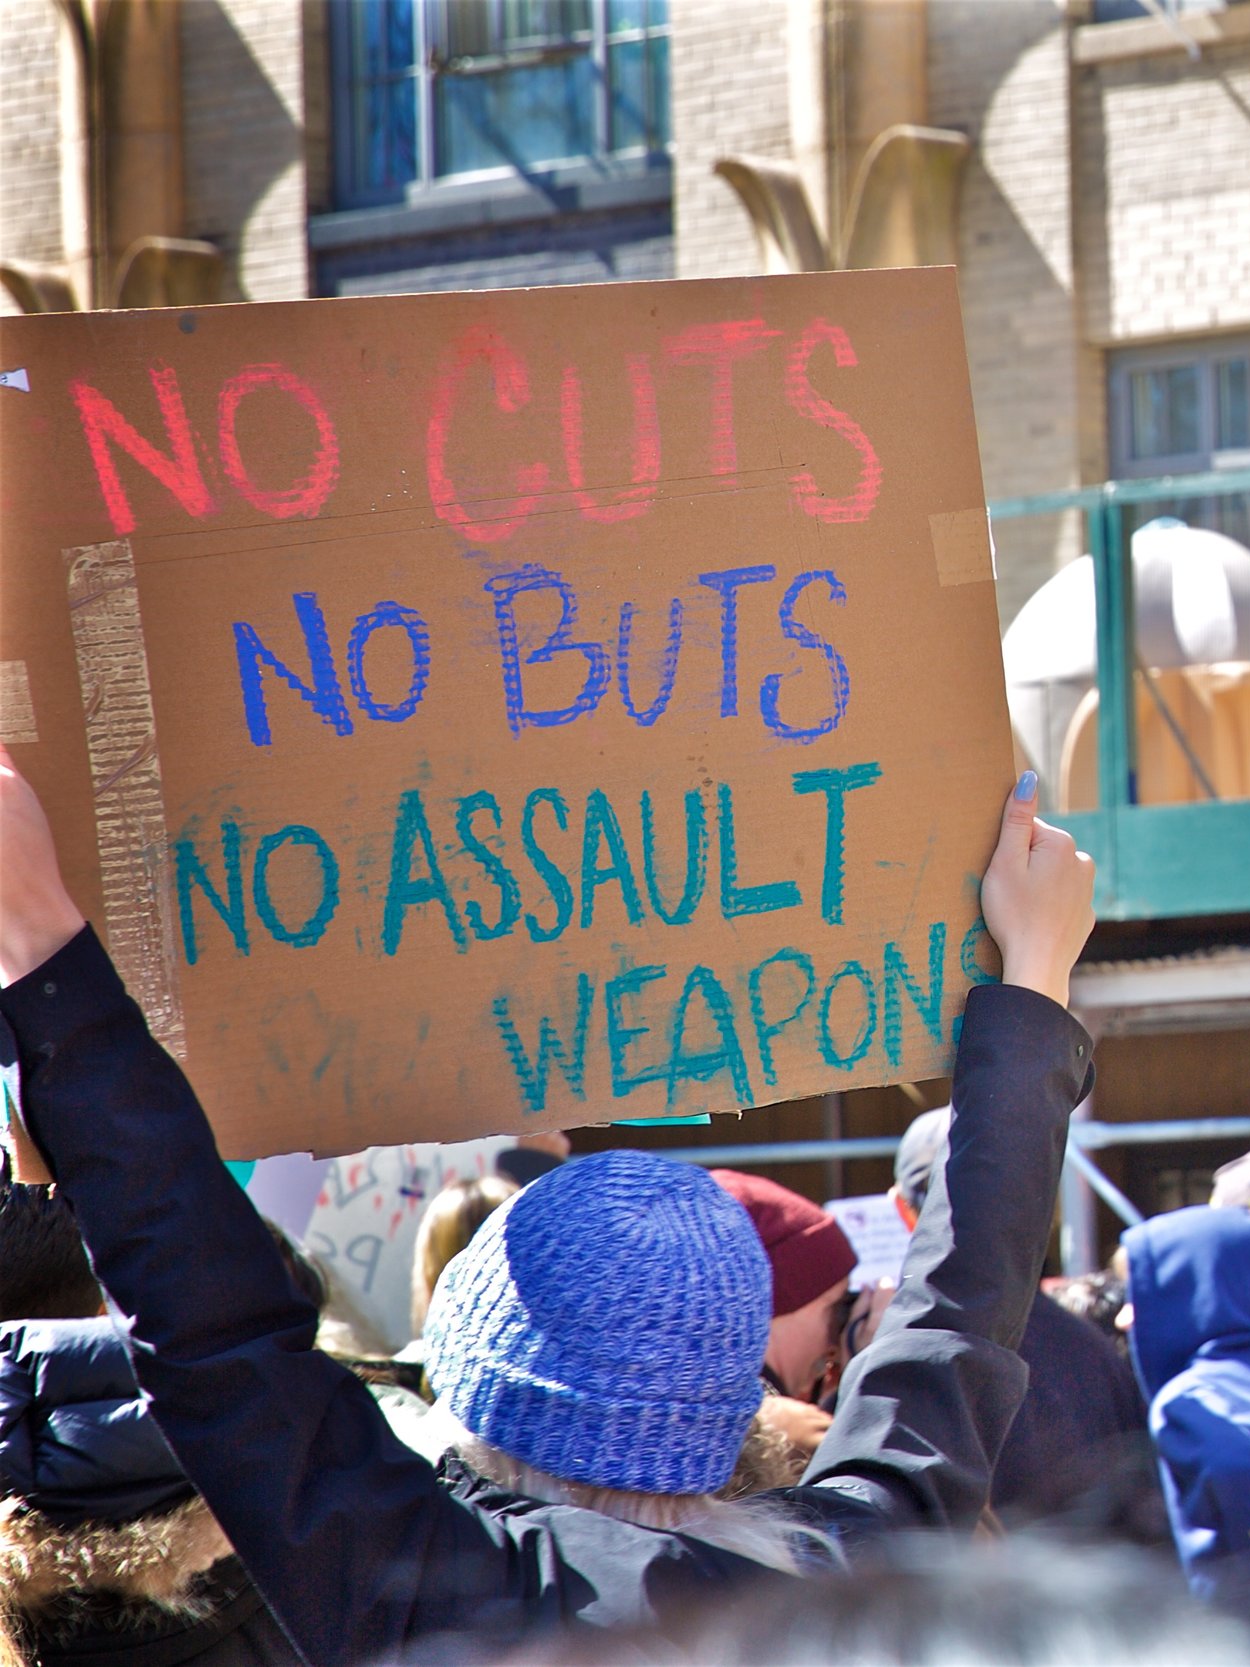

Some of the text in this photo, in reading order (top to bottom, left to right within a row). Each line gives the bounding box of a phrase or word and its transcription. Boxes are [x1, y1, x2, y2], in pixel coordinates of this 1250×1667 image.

[70, 318, 882, 542] NO CUTS
[232, 563, 851, 746] NO BUTS
[173, 762, 883, 965] NO ASSAULT
